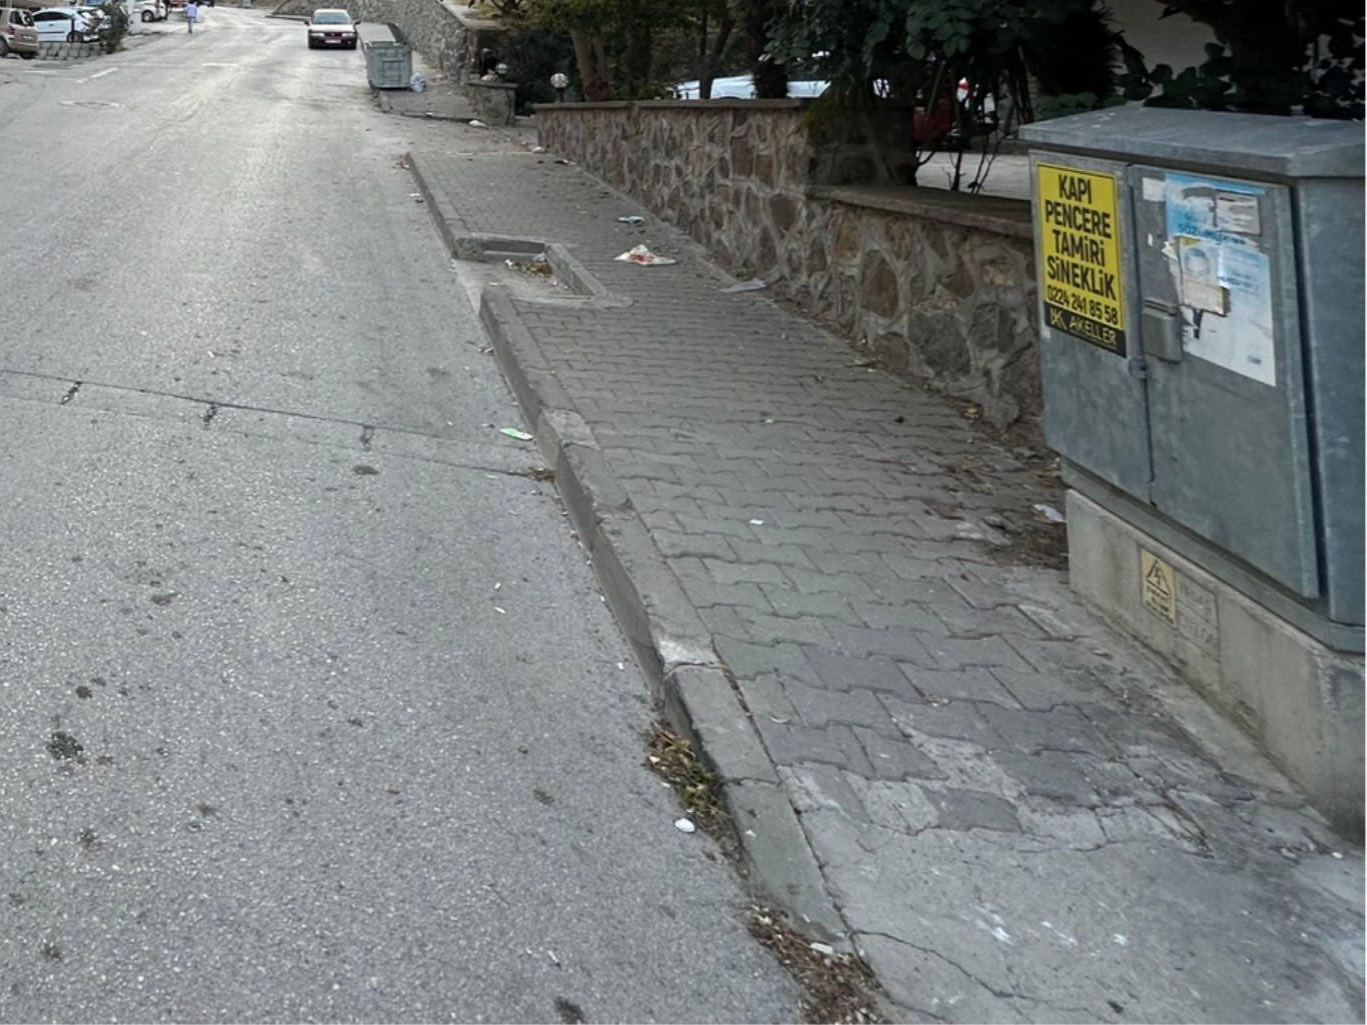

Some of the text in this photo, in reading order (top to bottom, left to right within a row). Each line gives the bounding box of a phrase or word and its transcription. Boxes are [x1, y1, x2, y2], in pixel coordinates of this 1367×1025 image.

[1058, 174, 1092, 205] KAPI
[1045, 199, 1112, 239] PENCERE
[1047, 284, 1070, 307] 0224
[1071, 292, 1088, 314] 241
